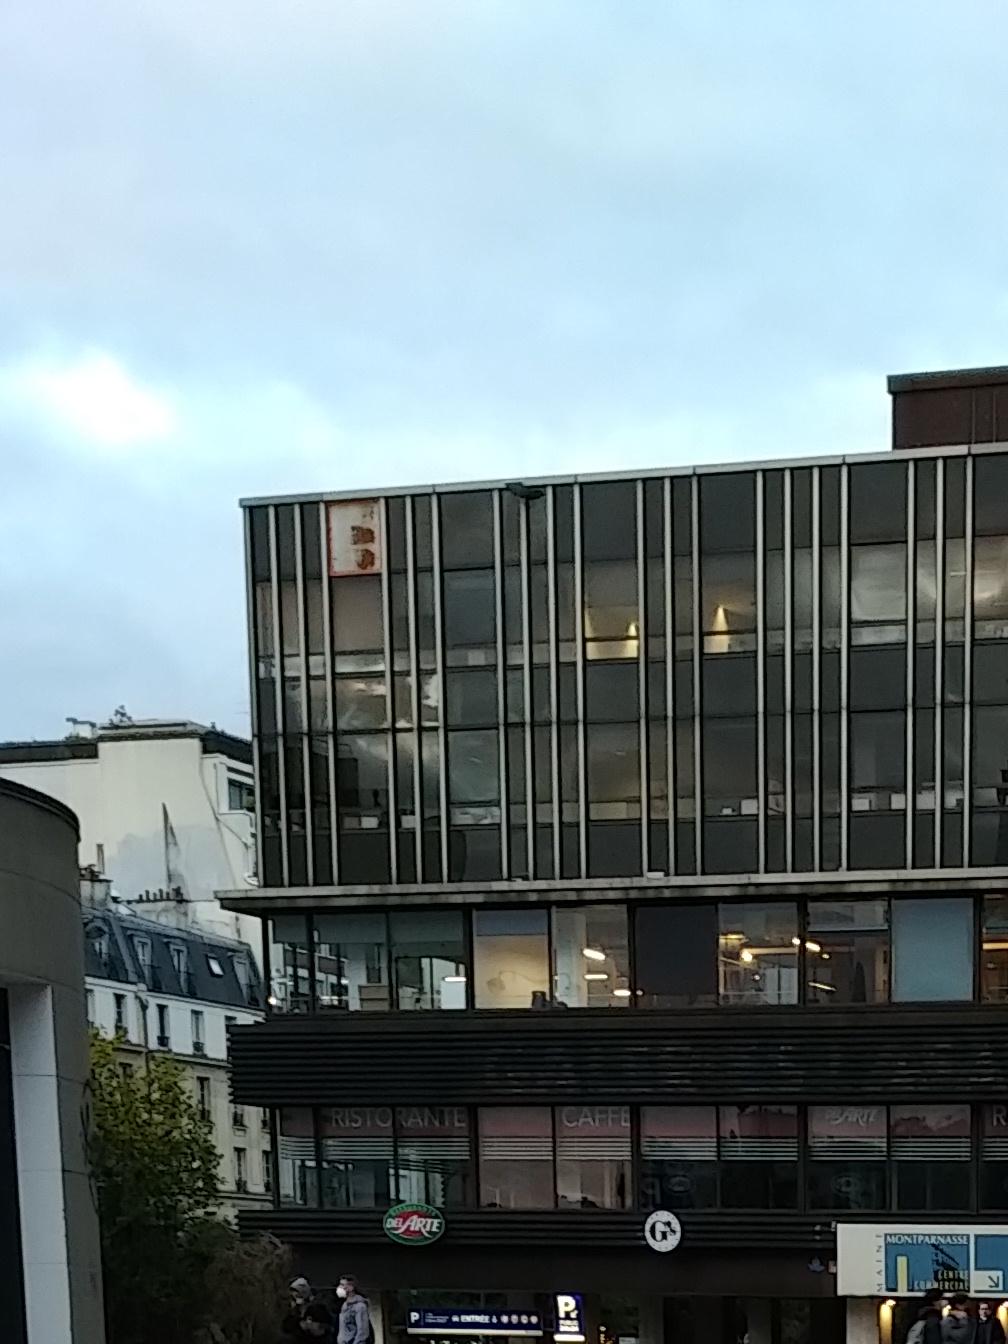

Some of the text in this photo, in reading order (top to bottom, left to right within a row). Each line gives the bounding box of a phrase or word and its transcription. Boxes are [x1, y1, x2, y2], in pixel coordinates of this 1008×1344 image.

[331, 1106, 467, 1128] RISTORANTE
[886, 1234, 969, 1245] MONTPARNASSE
[410, 1311, 420, 1323] P
